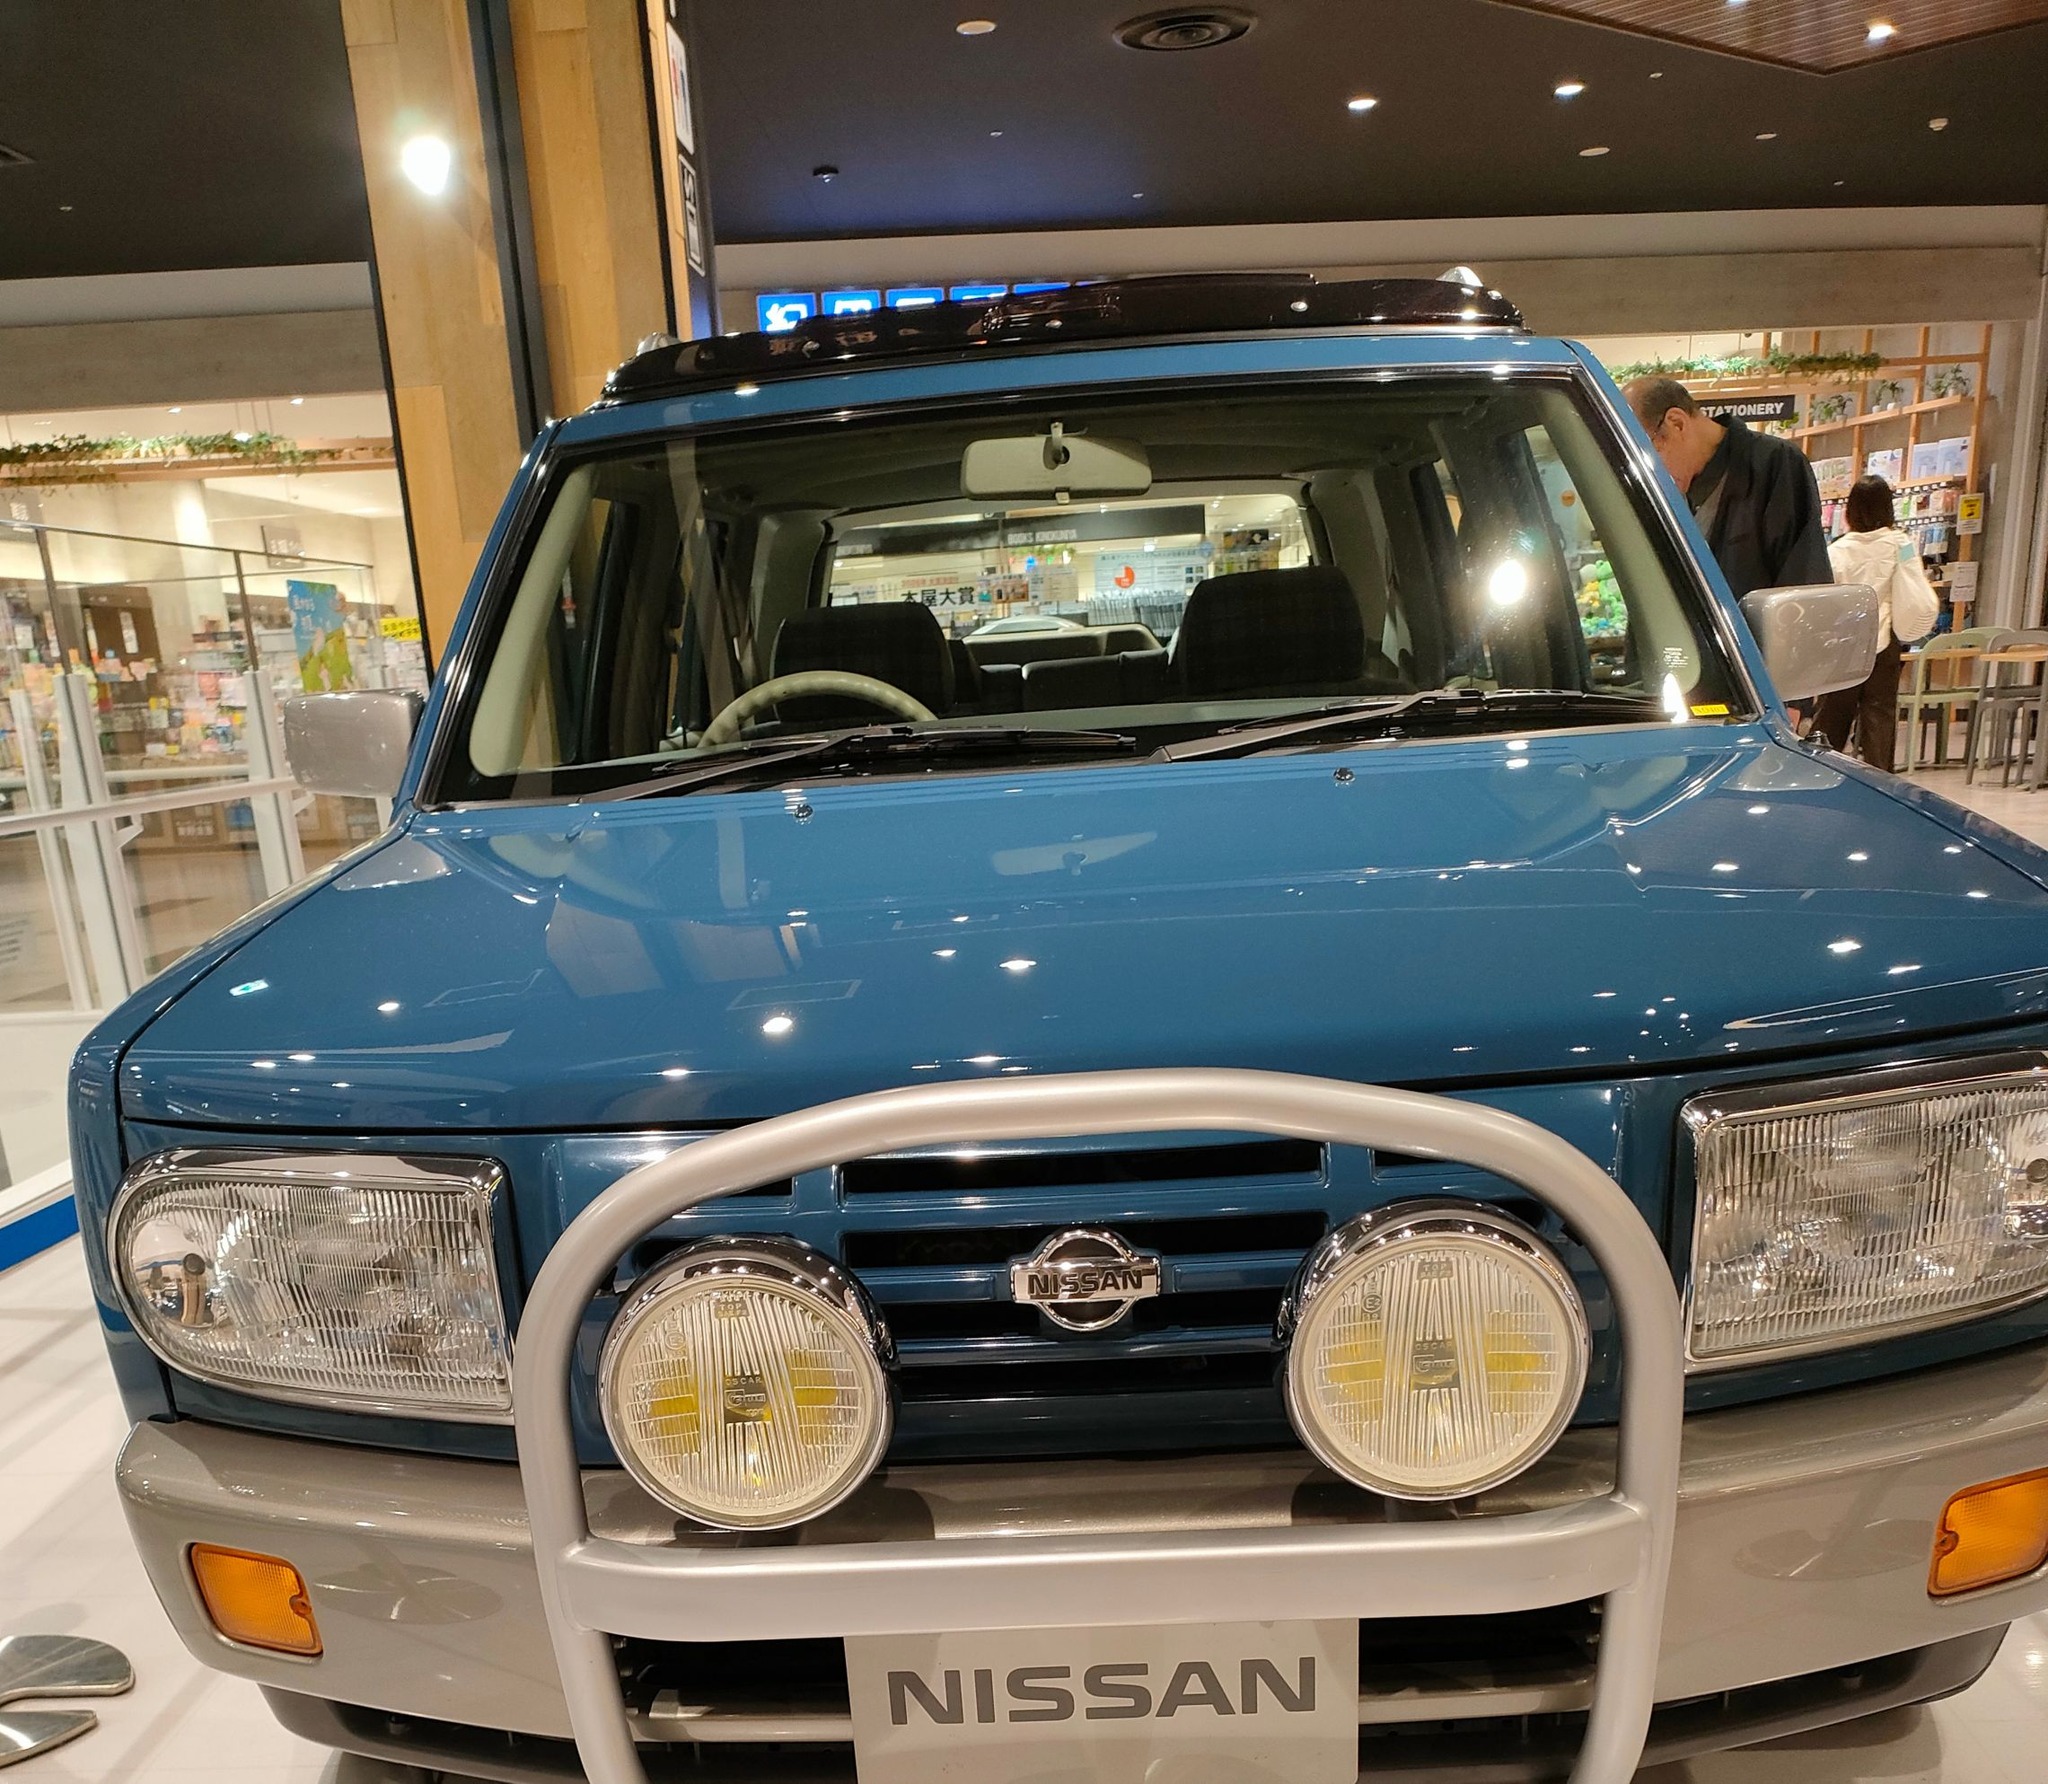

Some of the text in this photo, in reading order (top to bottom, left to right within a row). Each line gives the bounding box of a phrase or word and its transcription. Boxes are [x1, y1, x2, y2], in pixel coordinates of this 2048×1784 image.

[1699, 402, 1784, 417] STATIONERY
[900, 586, 975, 607] 本屋大賞
[1027, 1269, 1143, 1295] NISSAN
[719, 1303, 742, 1311] TOP
[1415, 1341, 1452, 1351] OSCAR
[725, 1376, 763, 1386] OSCAR
[887, 1656, 1316, 1726] NISSAN
